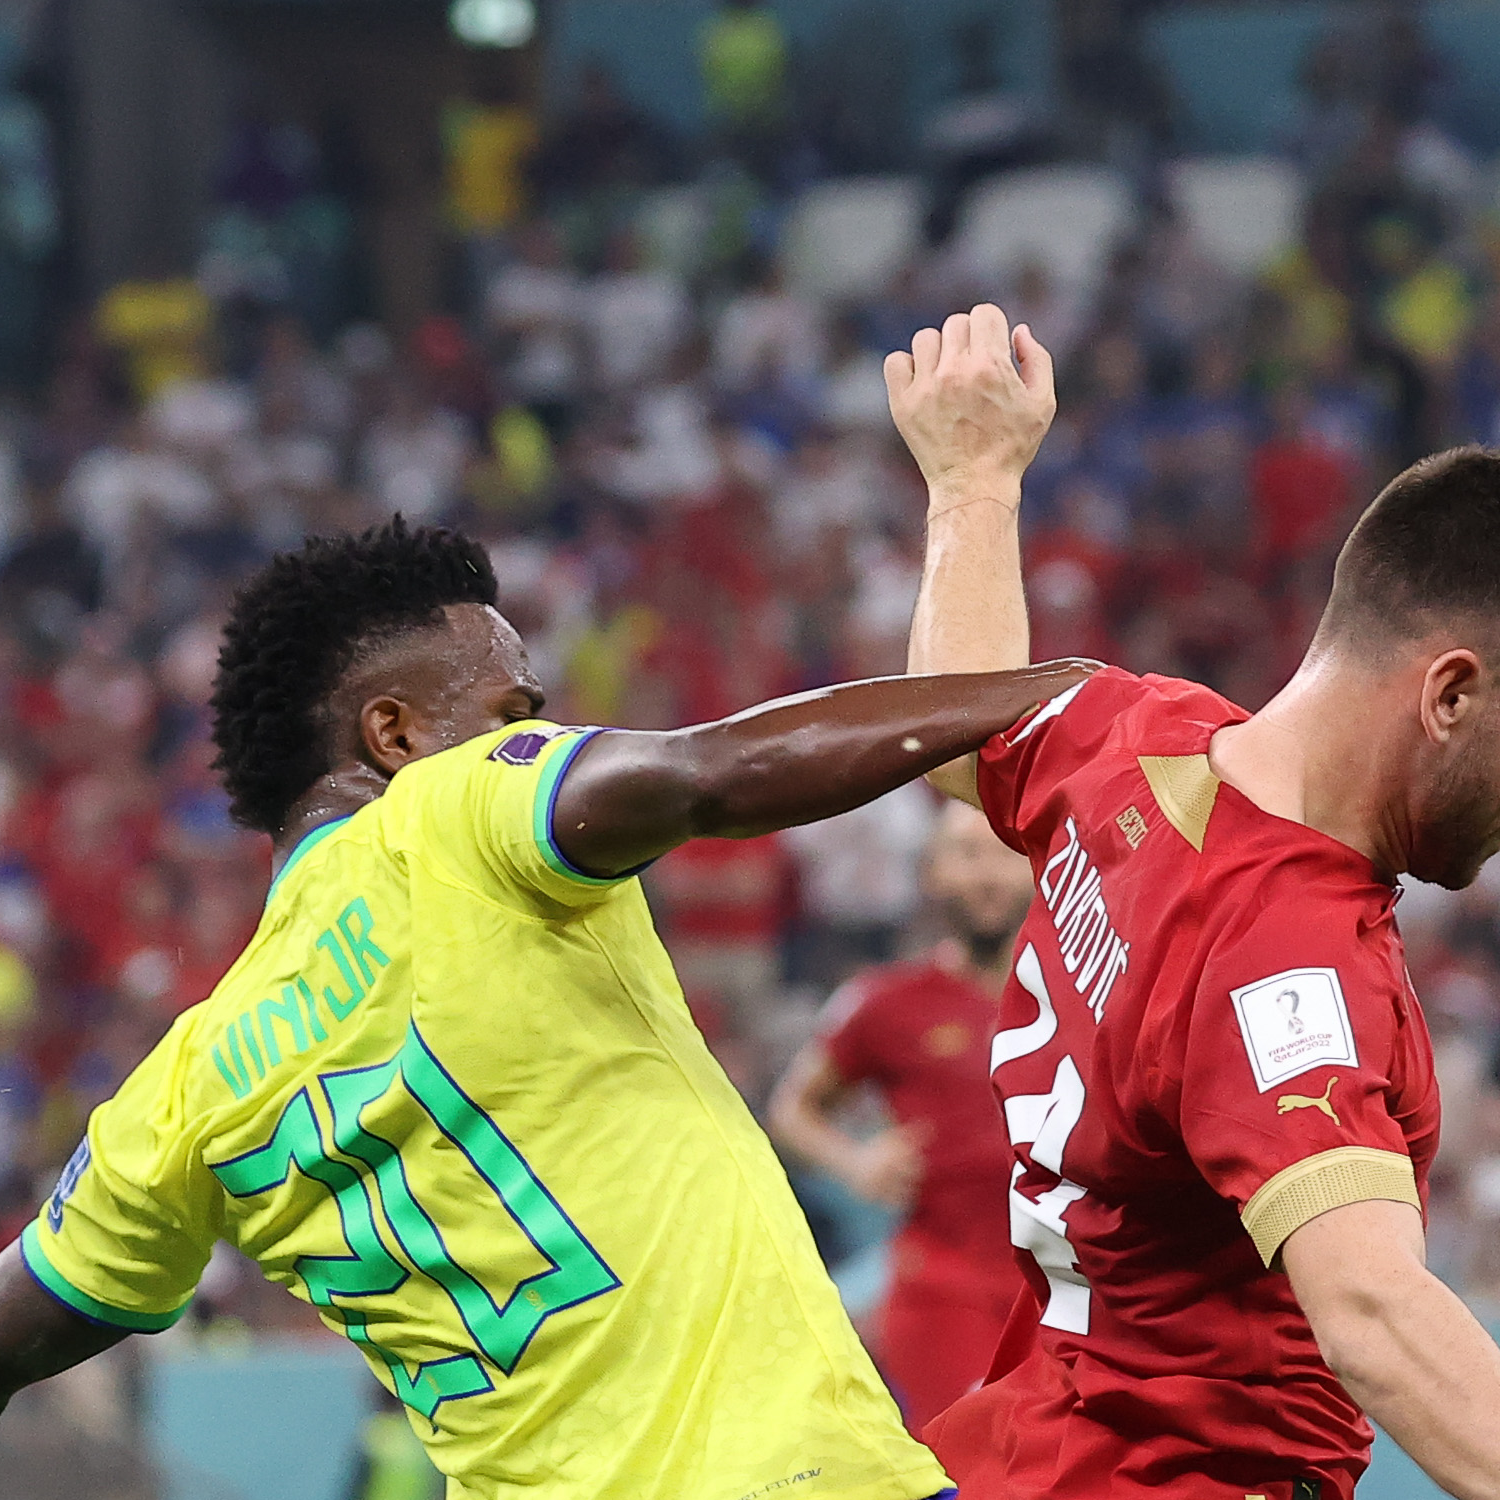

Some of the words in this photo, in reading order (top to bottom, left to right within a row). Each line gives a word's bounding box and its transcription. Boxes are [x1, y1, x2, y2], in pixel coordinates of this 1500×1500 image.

[1268, 1044, 1285, 1057] FIFA
[1287, 1035, 1315, 1049] WORLD
[206, 1012, 624, 1434] 20
